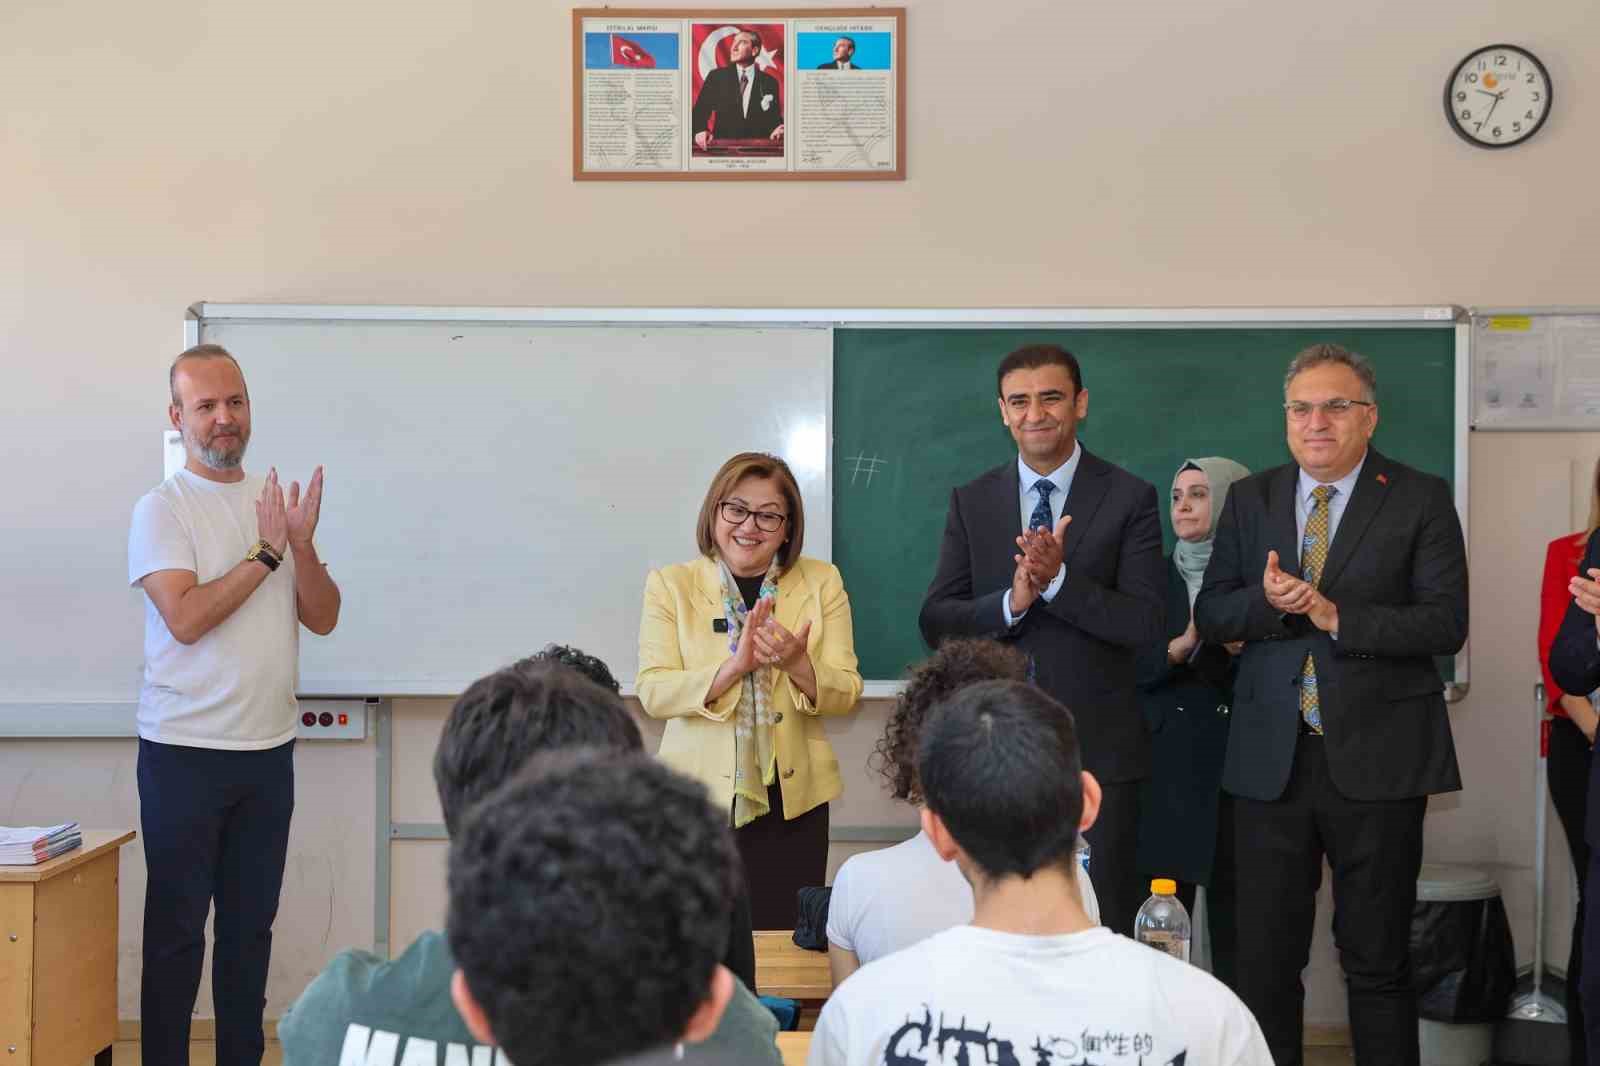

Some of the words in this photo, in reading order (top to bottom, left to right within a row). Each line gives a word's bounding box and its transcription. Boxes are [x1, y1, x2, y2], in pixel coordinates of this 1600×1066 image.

[1478, 61, 1486, 71] 11
[1494, 56, 1507, 66] 12
[1464, 73, 1478, 83] 10
[1526, 73, 1535, 83] 2
[1456, 91, 1466, 102] 9
[1531, 91, 1540, 102] 3
[1461, 110, 1471, 120] 8
[1525, 110, 1533, 120] 4
[1473, 122, 1482, 133] 7
[1492, 126, 1502, 137] 6
[1512, 122, 1521, 132] 5
